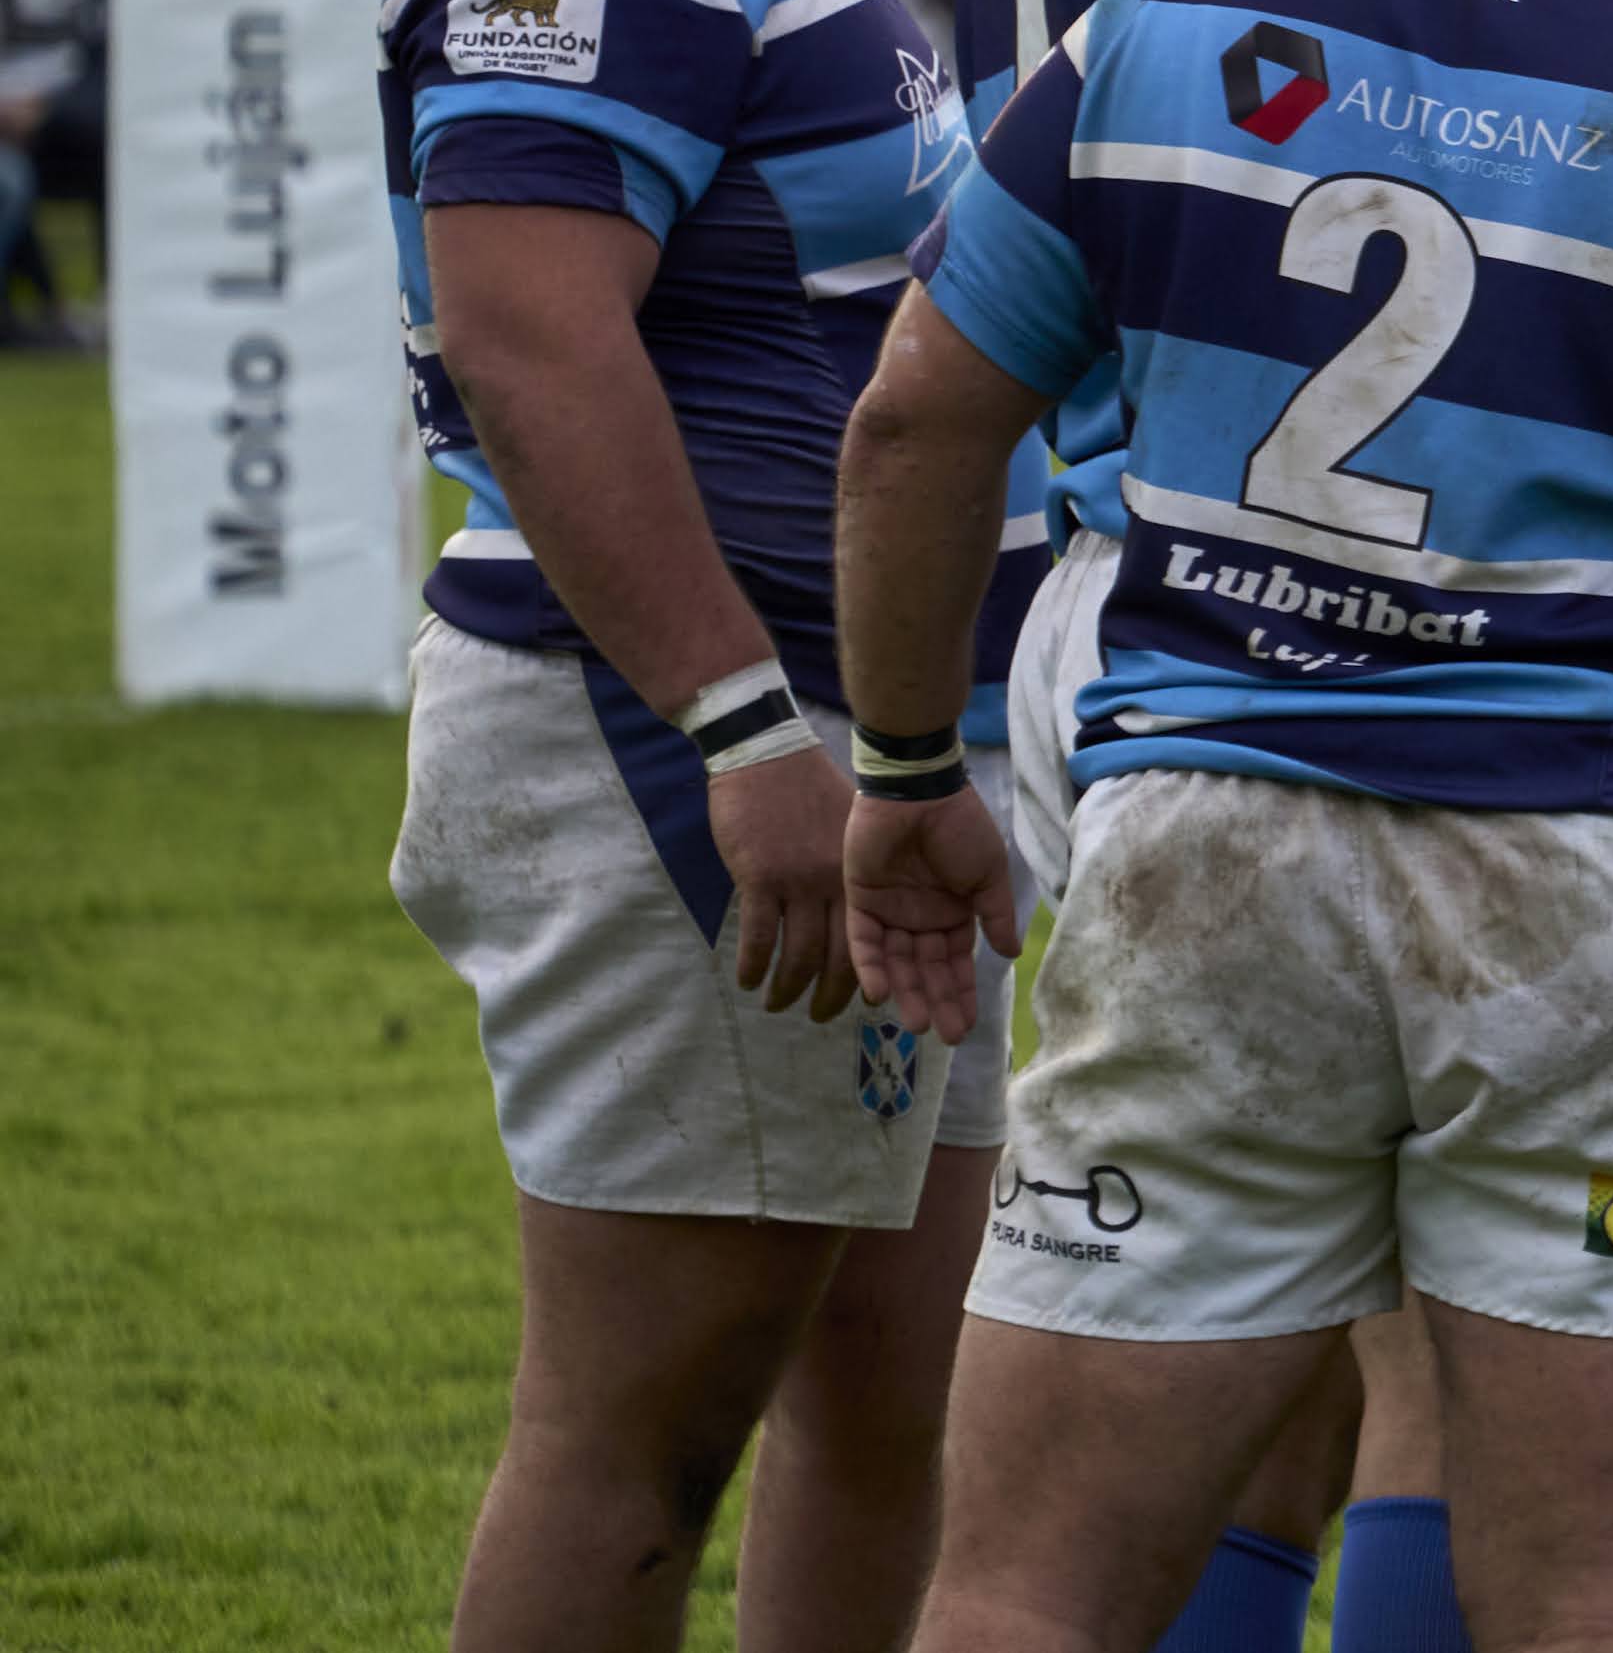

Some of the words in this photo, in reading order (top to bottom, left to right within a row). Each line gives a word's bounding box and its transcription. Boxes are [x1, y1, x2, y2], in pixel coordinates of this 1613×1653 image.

[447, 30, 597, 56] FUNDACIÓN
[458, 49, 500, 60] UNIÓN
[501, 51, 578, 67] ARGENTINA
[482, 59, 500, 69] DE
[503, 61, 549, 73] RUGBY
[1336, 77, 1606, 172] AUTOSANZ
[1390, 144, 1537, 187] AUTOMOTORES
[1238, 171, 1480, 552] 2
[208, 332, 288, 597] Moto
[1160, 543, 1493, 648] Lubribat
[991, 1219, 1026, 1249] PURA
[1029, 1232, 1121, 1264] SANGRE
